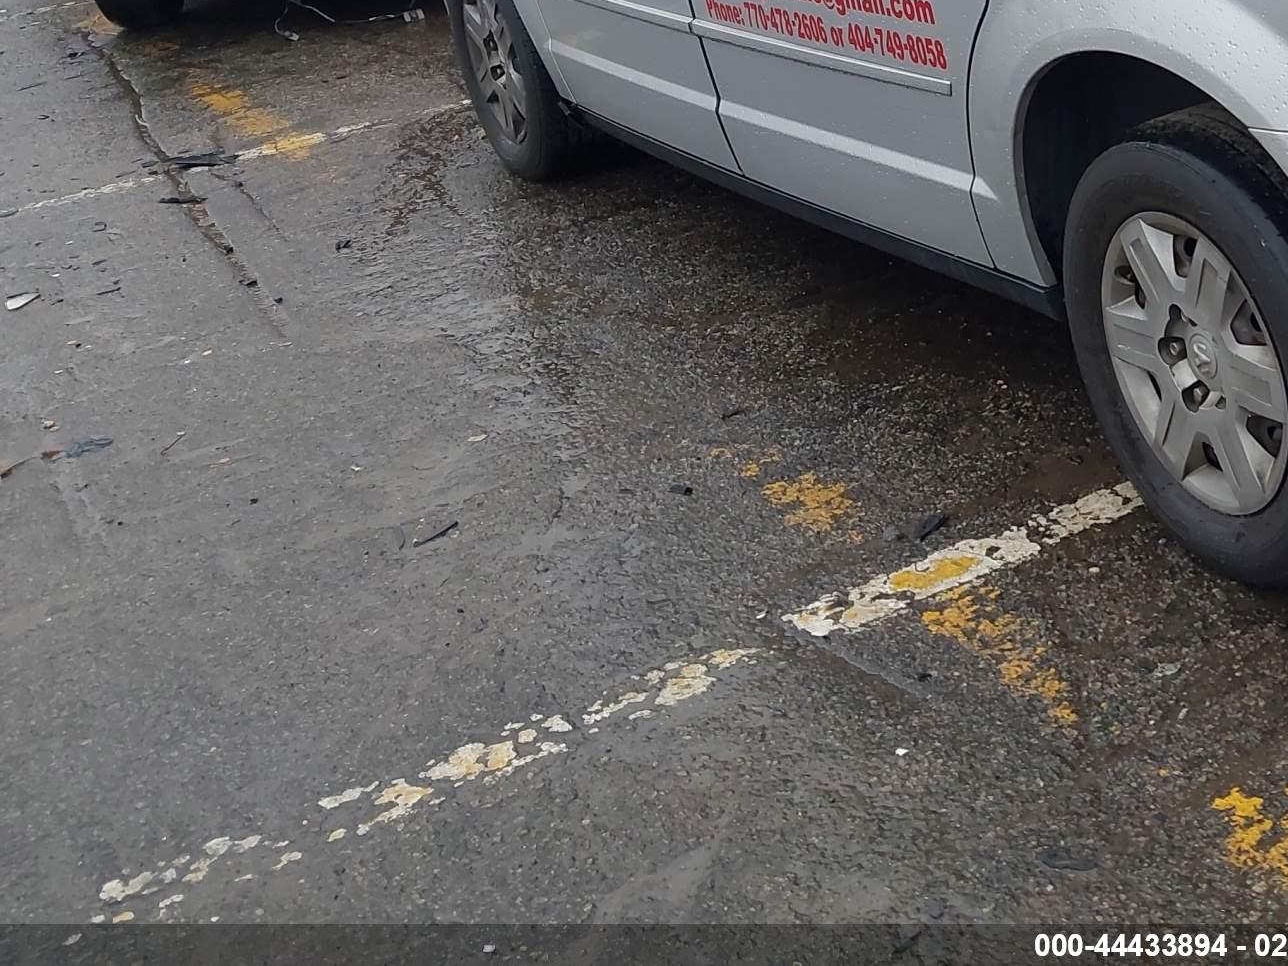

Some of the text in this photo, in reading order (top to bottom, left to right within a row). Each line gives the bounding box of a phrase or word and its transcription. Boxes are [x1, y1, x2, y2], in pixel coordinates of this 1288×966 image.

[744, 2, 828, 44] 770-478-2606
[830, 26, 845, 48] or
[848, 22, 948, 70] 404-749-8058
